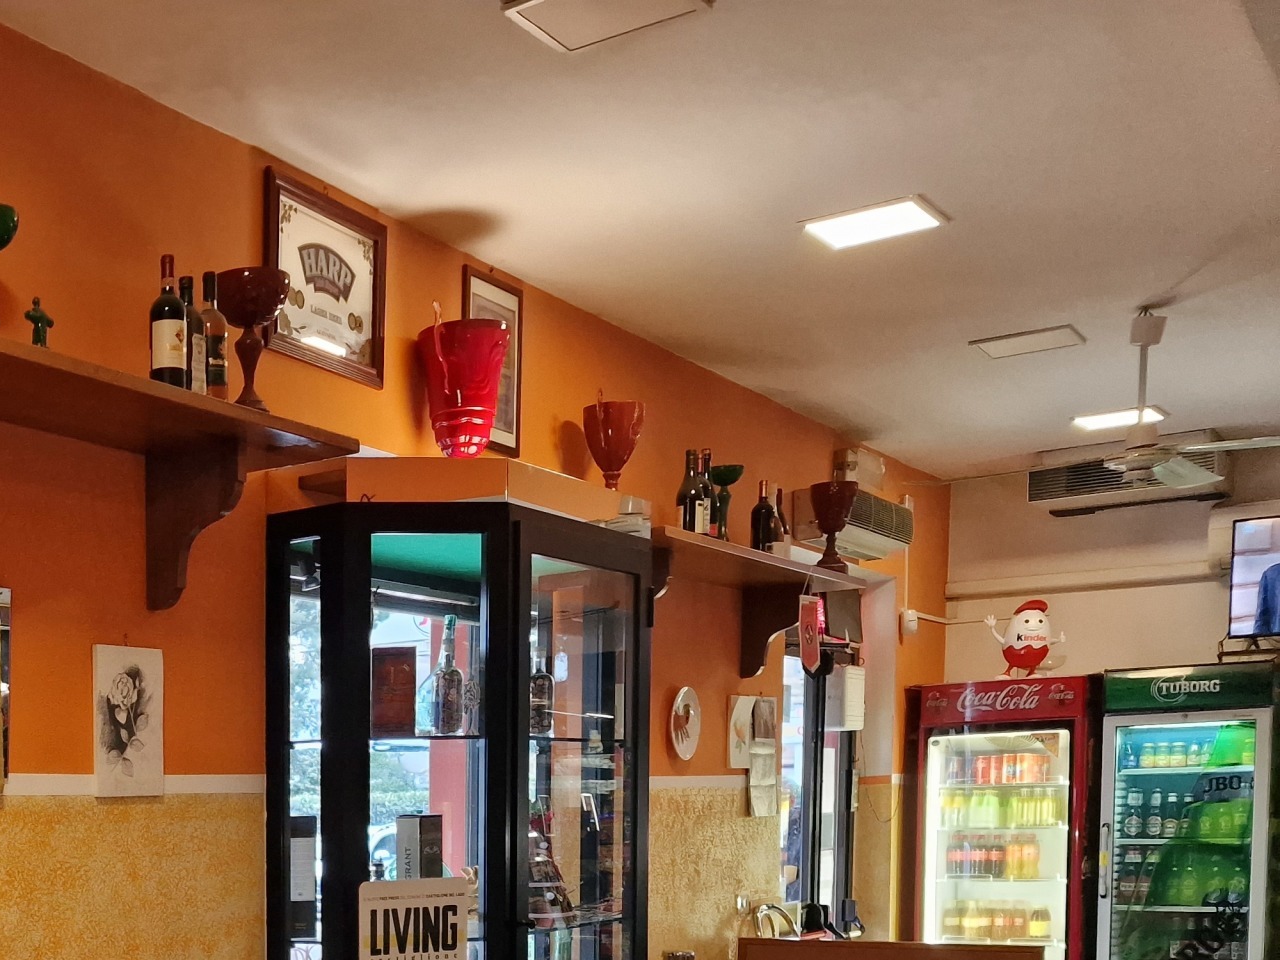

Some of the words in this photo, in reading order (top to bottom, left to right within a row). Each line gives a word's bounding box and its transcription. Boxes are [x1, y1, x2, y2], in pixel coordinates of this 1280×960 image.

[301, 248, 352, 290] HARP
[1016, 633, 1048, 643] kinder
[956, 683, 1043, 712] Coca-Cola
[1159, 679, 1220, 695] TUBORG
[370, 905, 458, 956] LIVING
